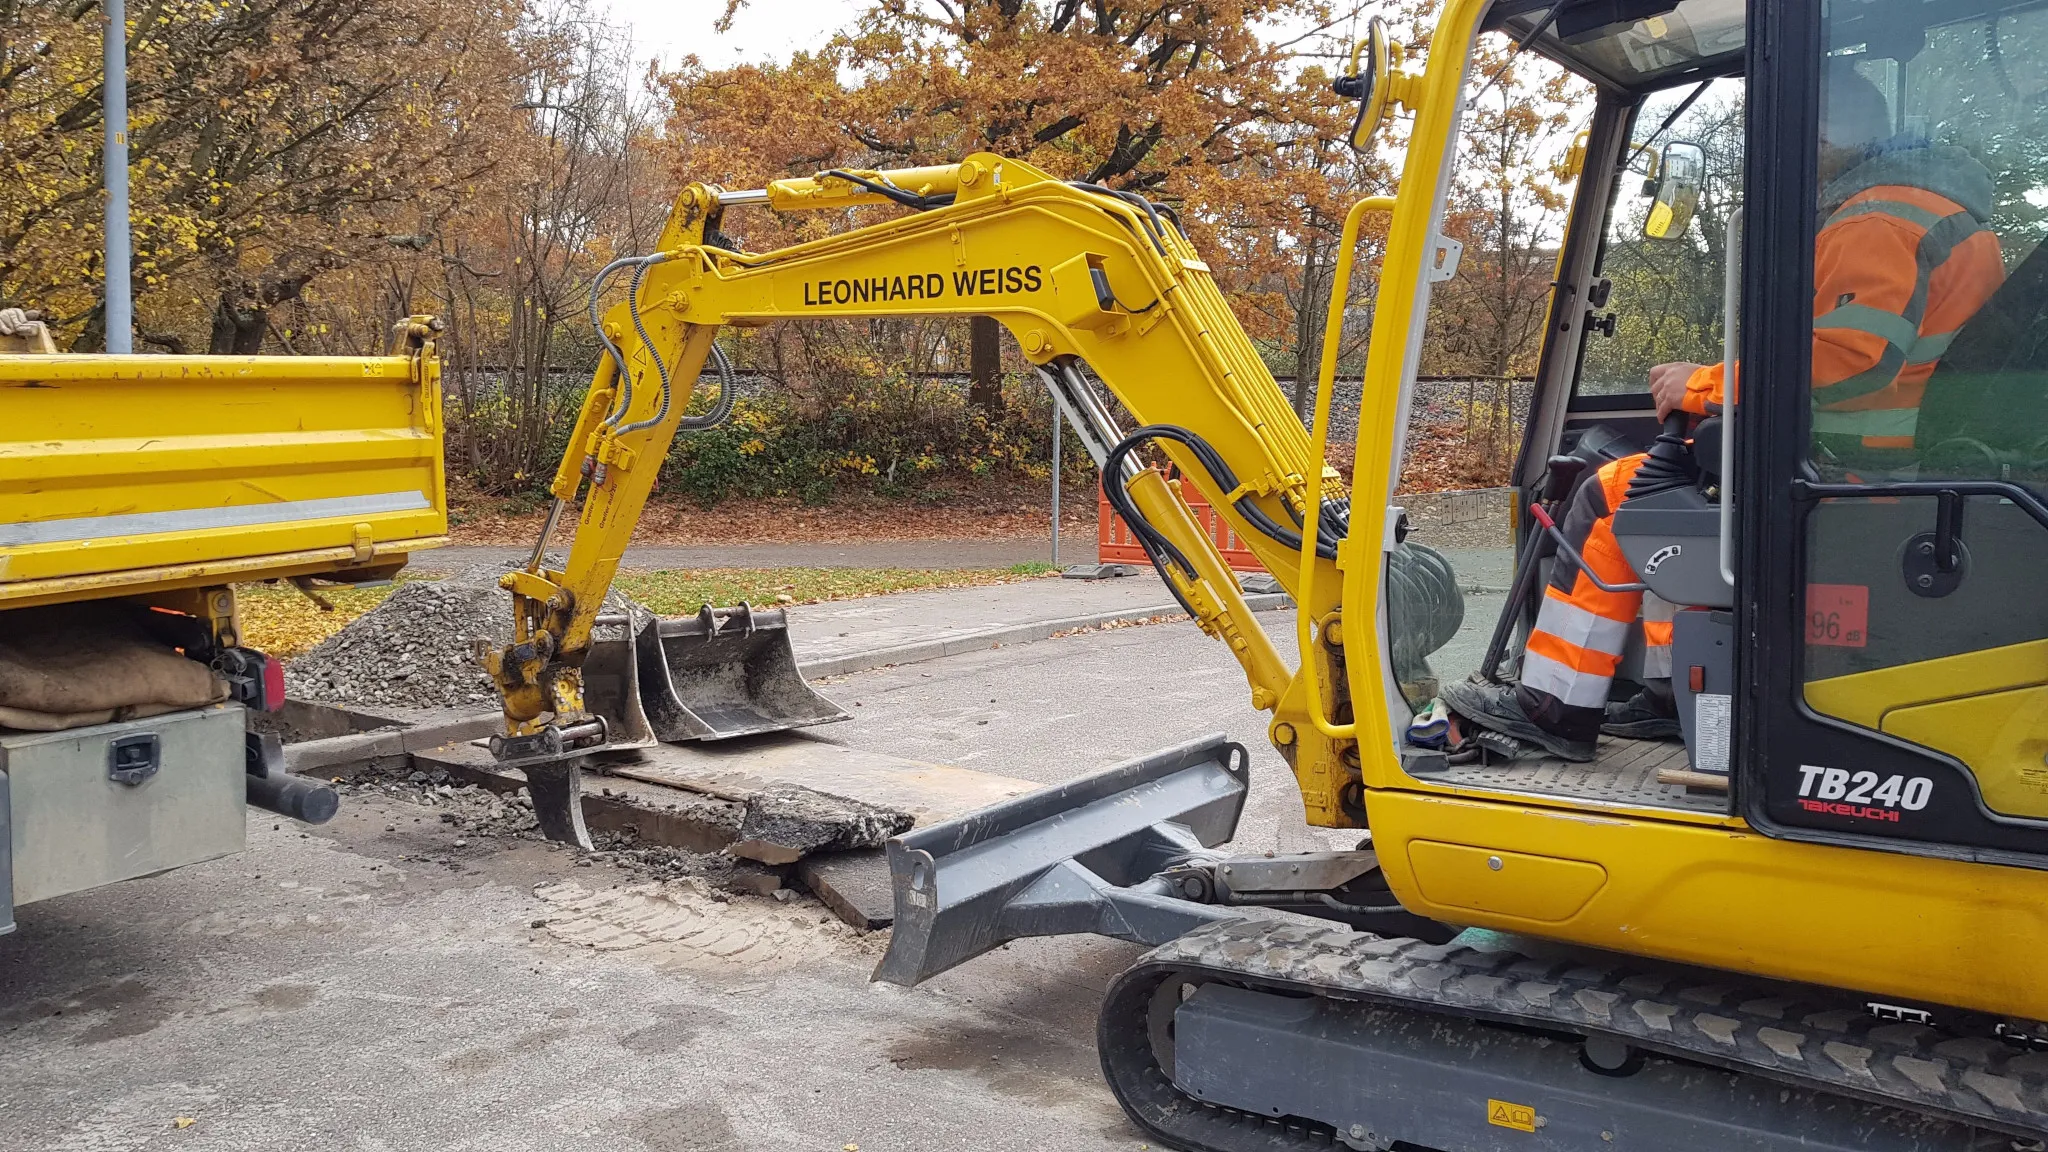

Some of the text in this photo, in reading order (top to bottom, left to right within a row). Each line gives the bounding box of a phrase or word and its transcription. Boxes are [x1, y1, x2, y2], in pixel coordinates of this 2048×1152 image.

[804, 265, 1042, 305] LEONHARD WEISS
[1811, 611, 1840, 640] 96
[1798, 764, 1934, 811] TB240
